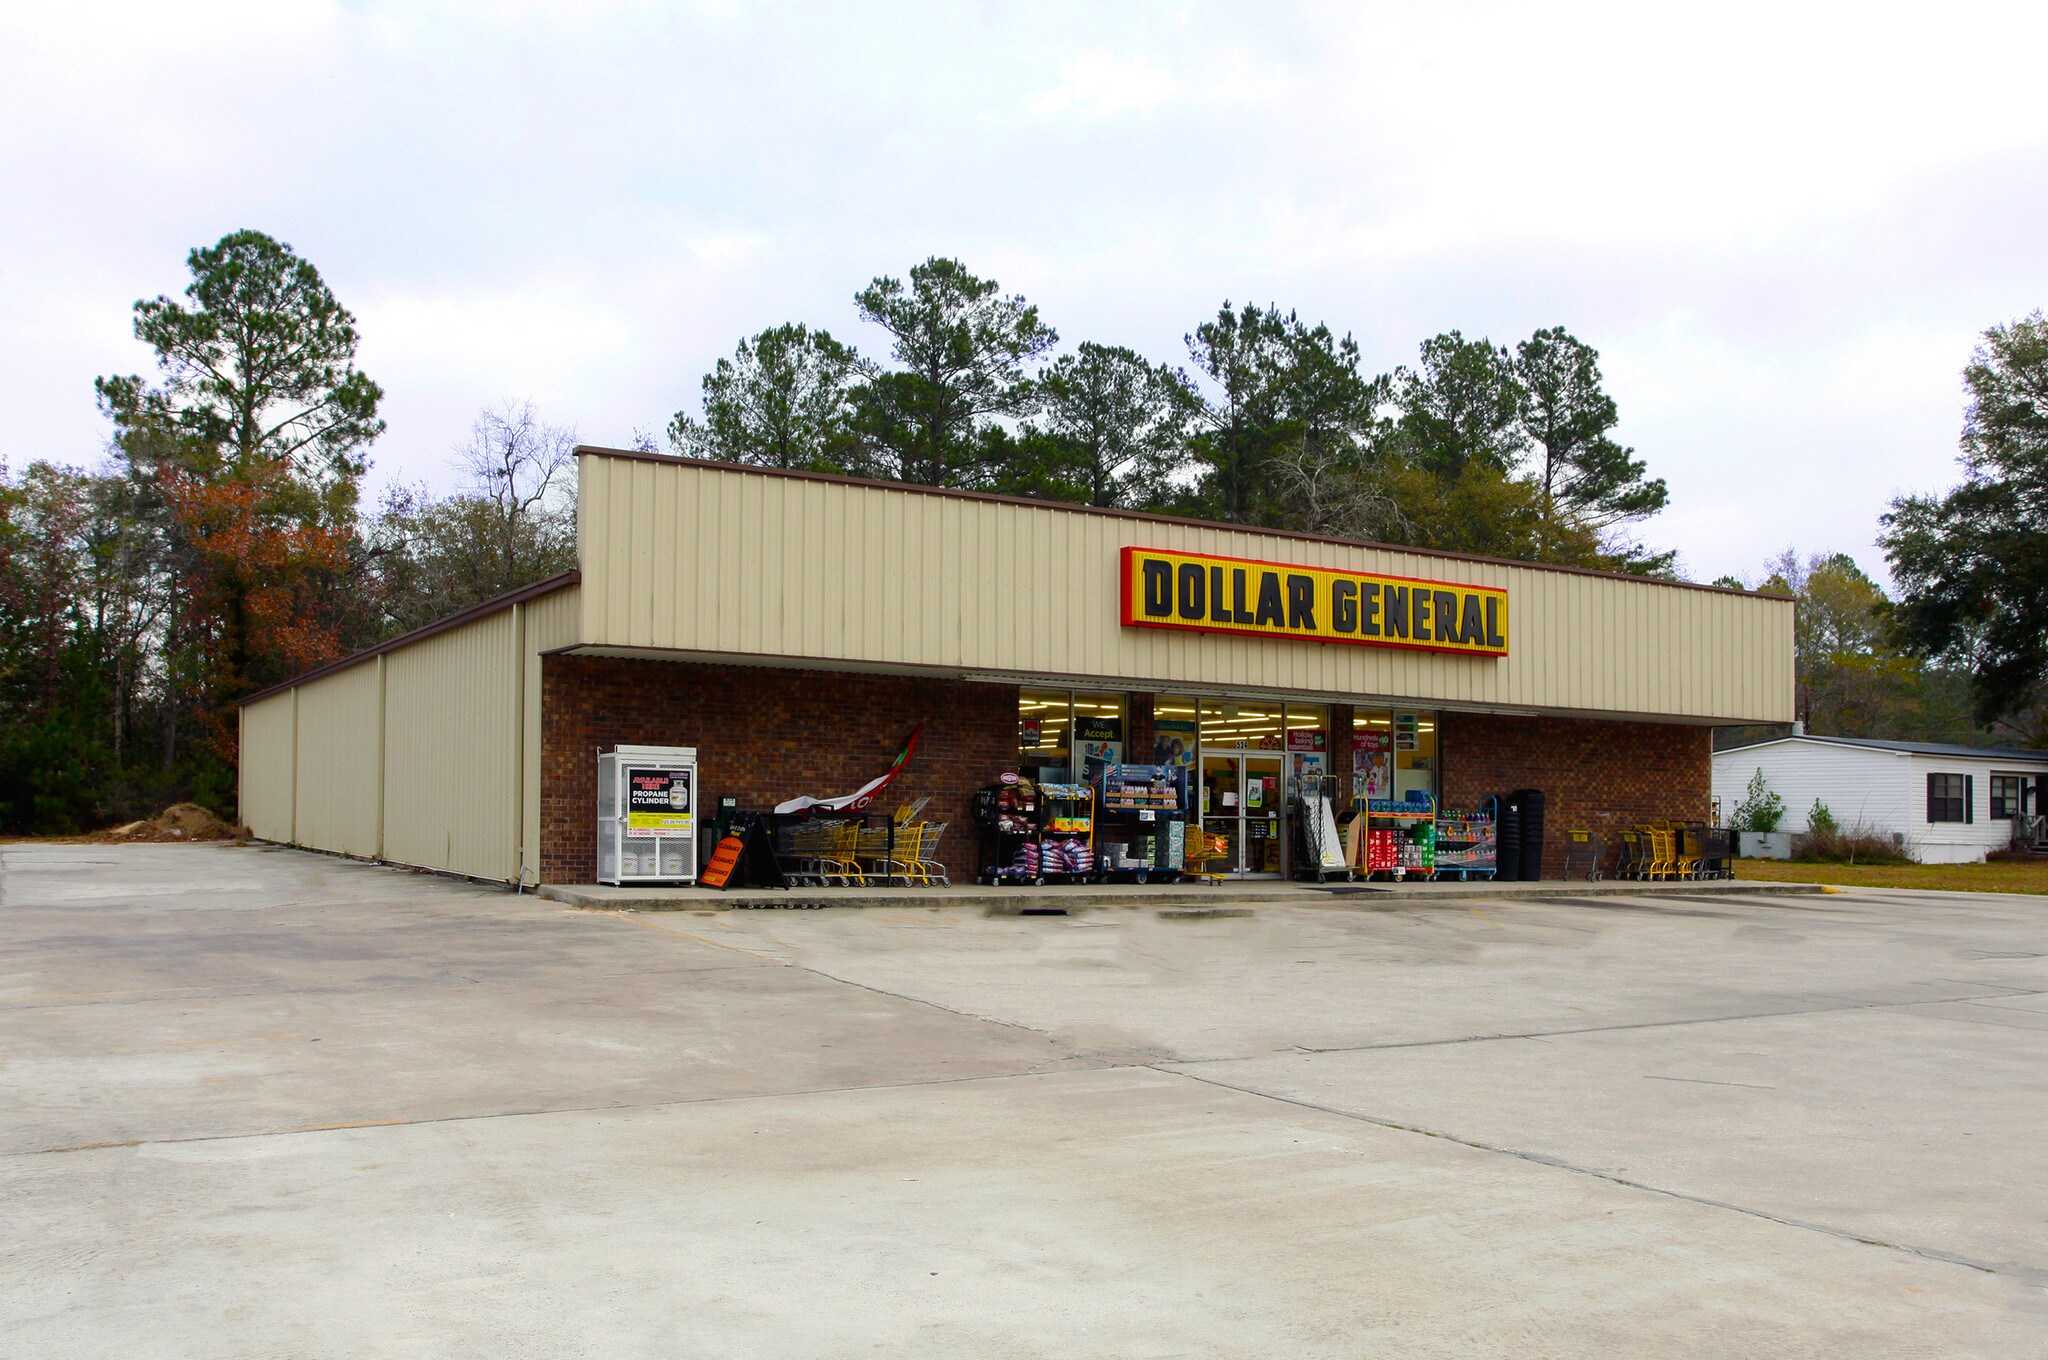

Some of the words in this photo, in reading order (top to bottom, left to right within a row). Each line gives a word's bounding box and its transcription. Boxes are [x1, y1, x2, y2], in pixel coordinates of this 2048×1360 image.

[1142, 557, 1317, 630] DOLLAR
[1332, 579, 1504, 648] GENERAL
[1092, 720, 1105, 728] WE
[1083, 729, 1114, 739] Accept
[1236, 741, 1248, 749] 534
[1295, 737, 1314, 745] baking
